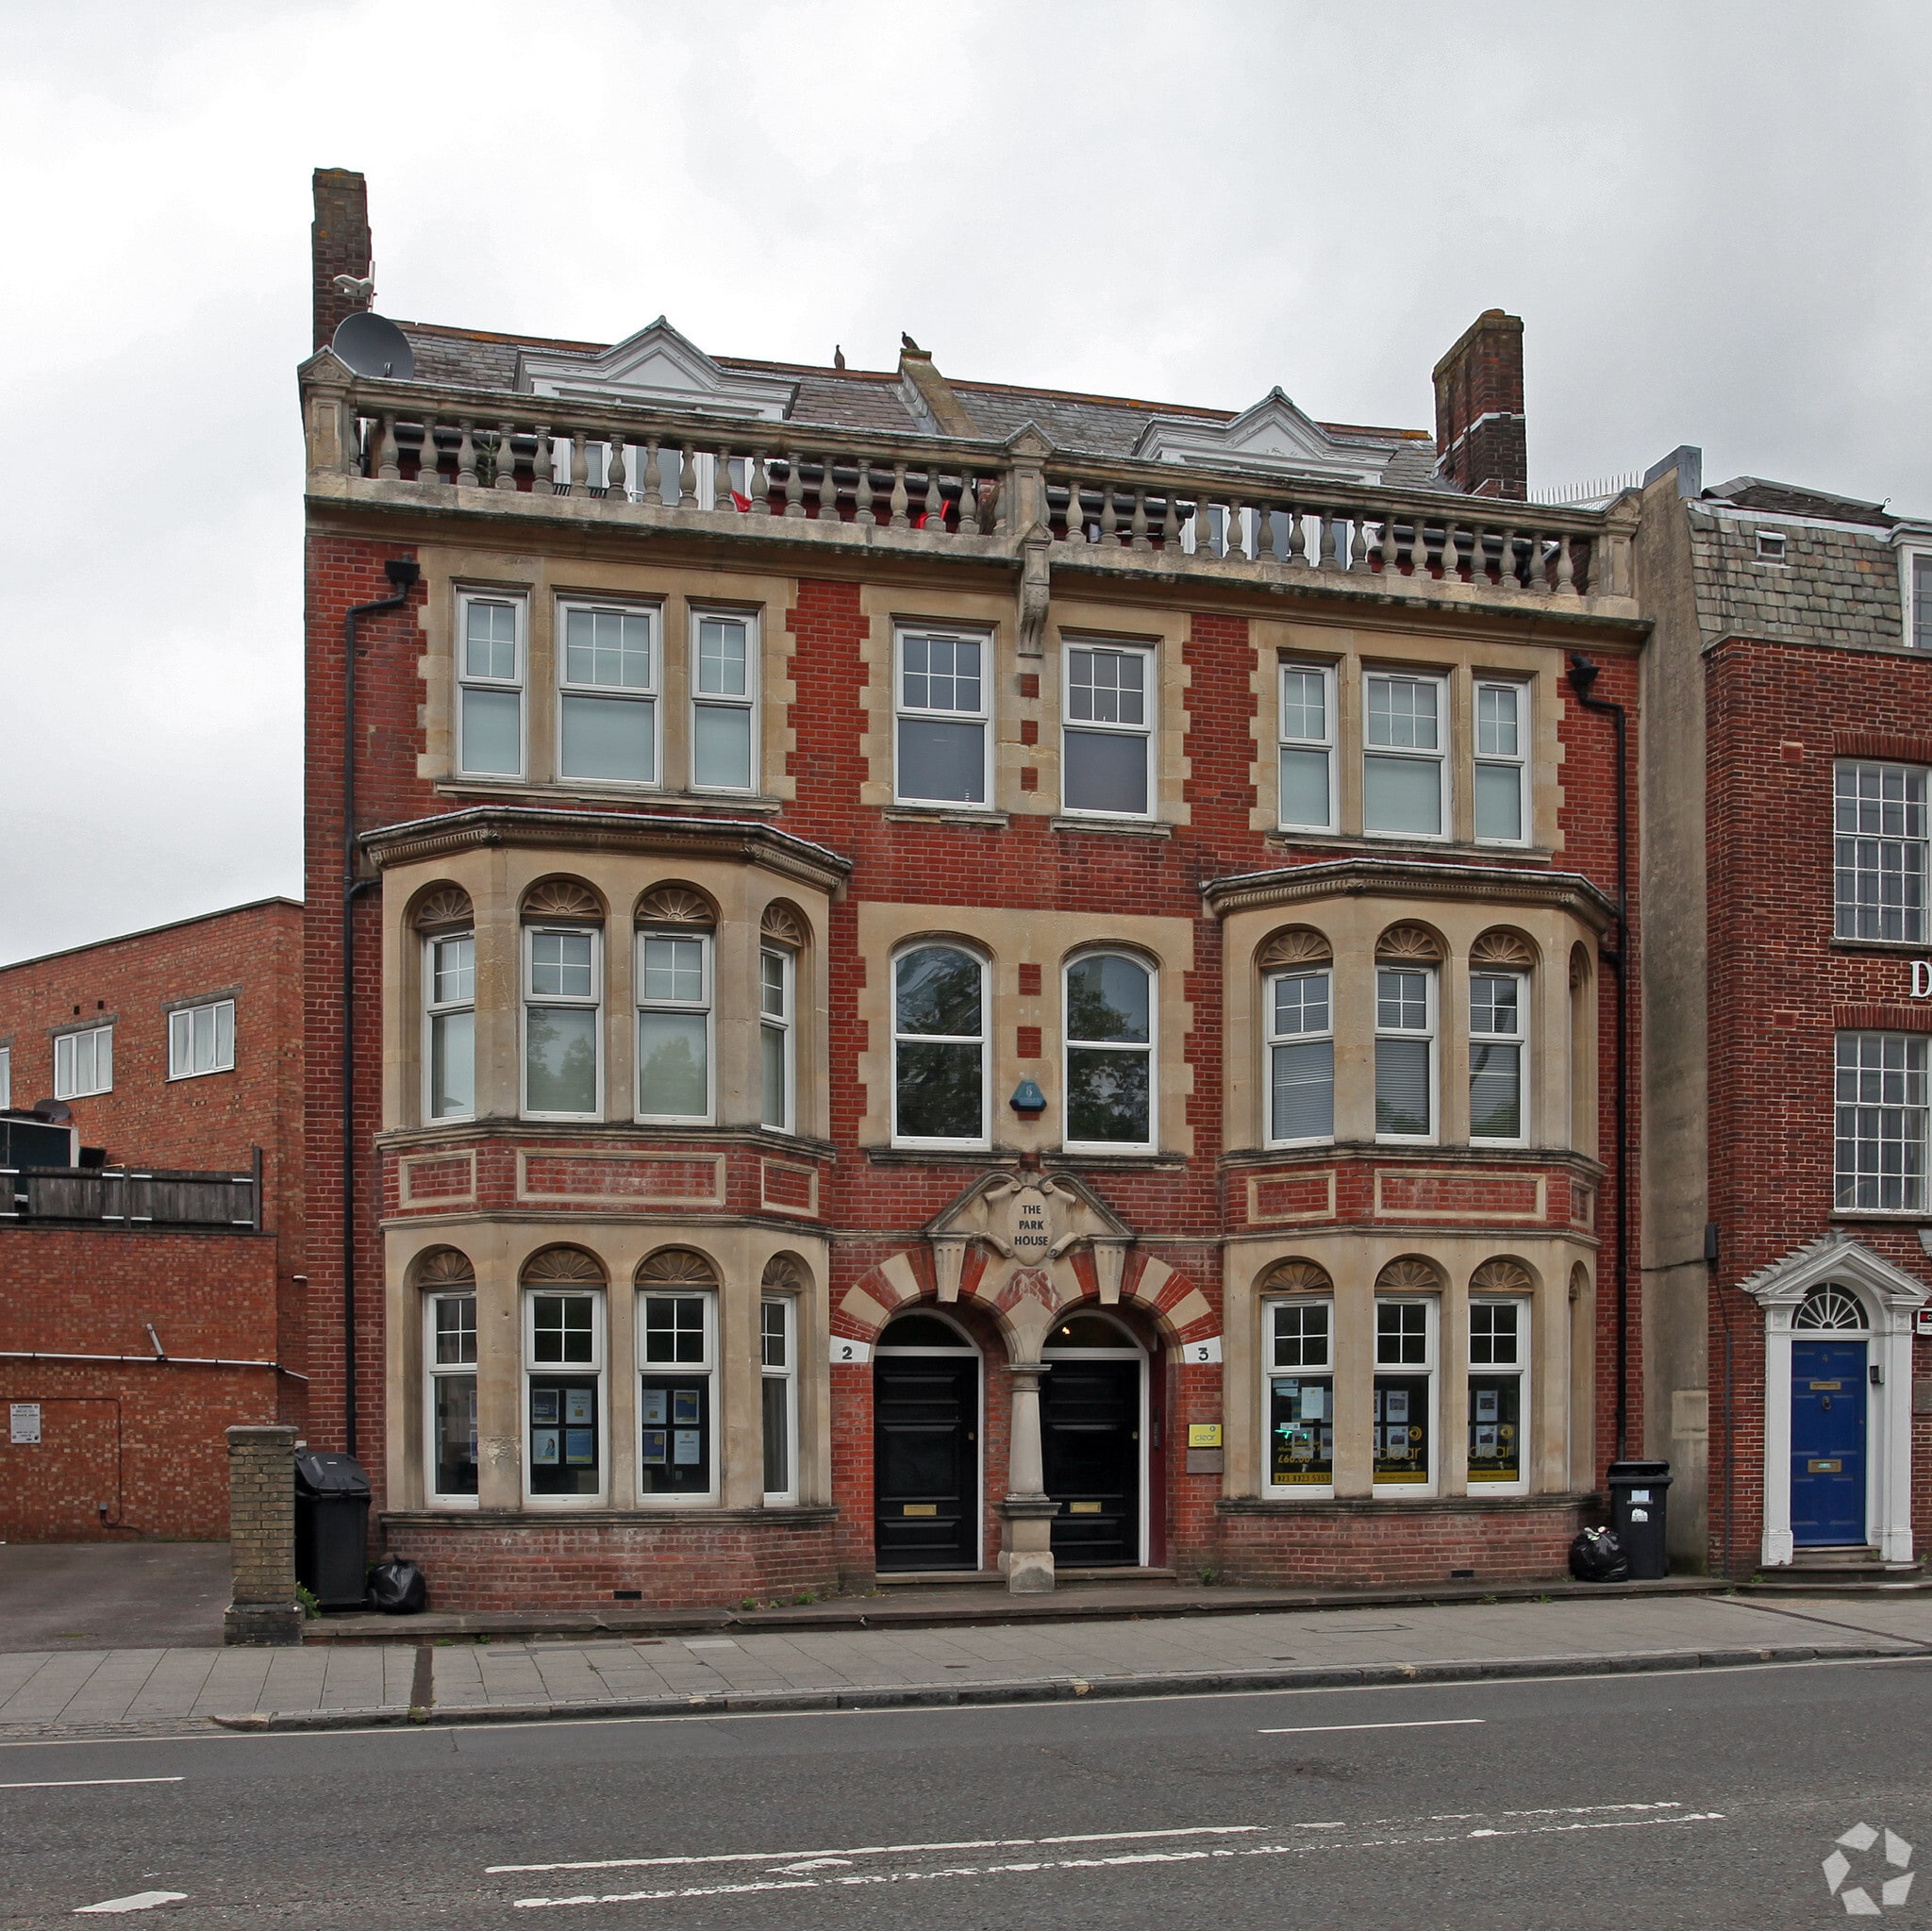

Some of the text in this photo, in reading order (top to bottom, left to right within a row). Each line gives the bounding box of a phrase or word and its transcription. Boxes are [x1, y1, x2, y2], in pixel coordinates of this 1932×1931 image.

[1022, 1205, 1041, 1215] THE
[1019, 1220, 1044, 1230] PARK
[1014, 1236, 1048, 1246] HOUSE
[841, 1345, 853, 1360] 2
[1198, 1347, 1208, 1360] 3
[1194, 1433, 1216, 1441] clear
